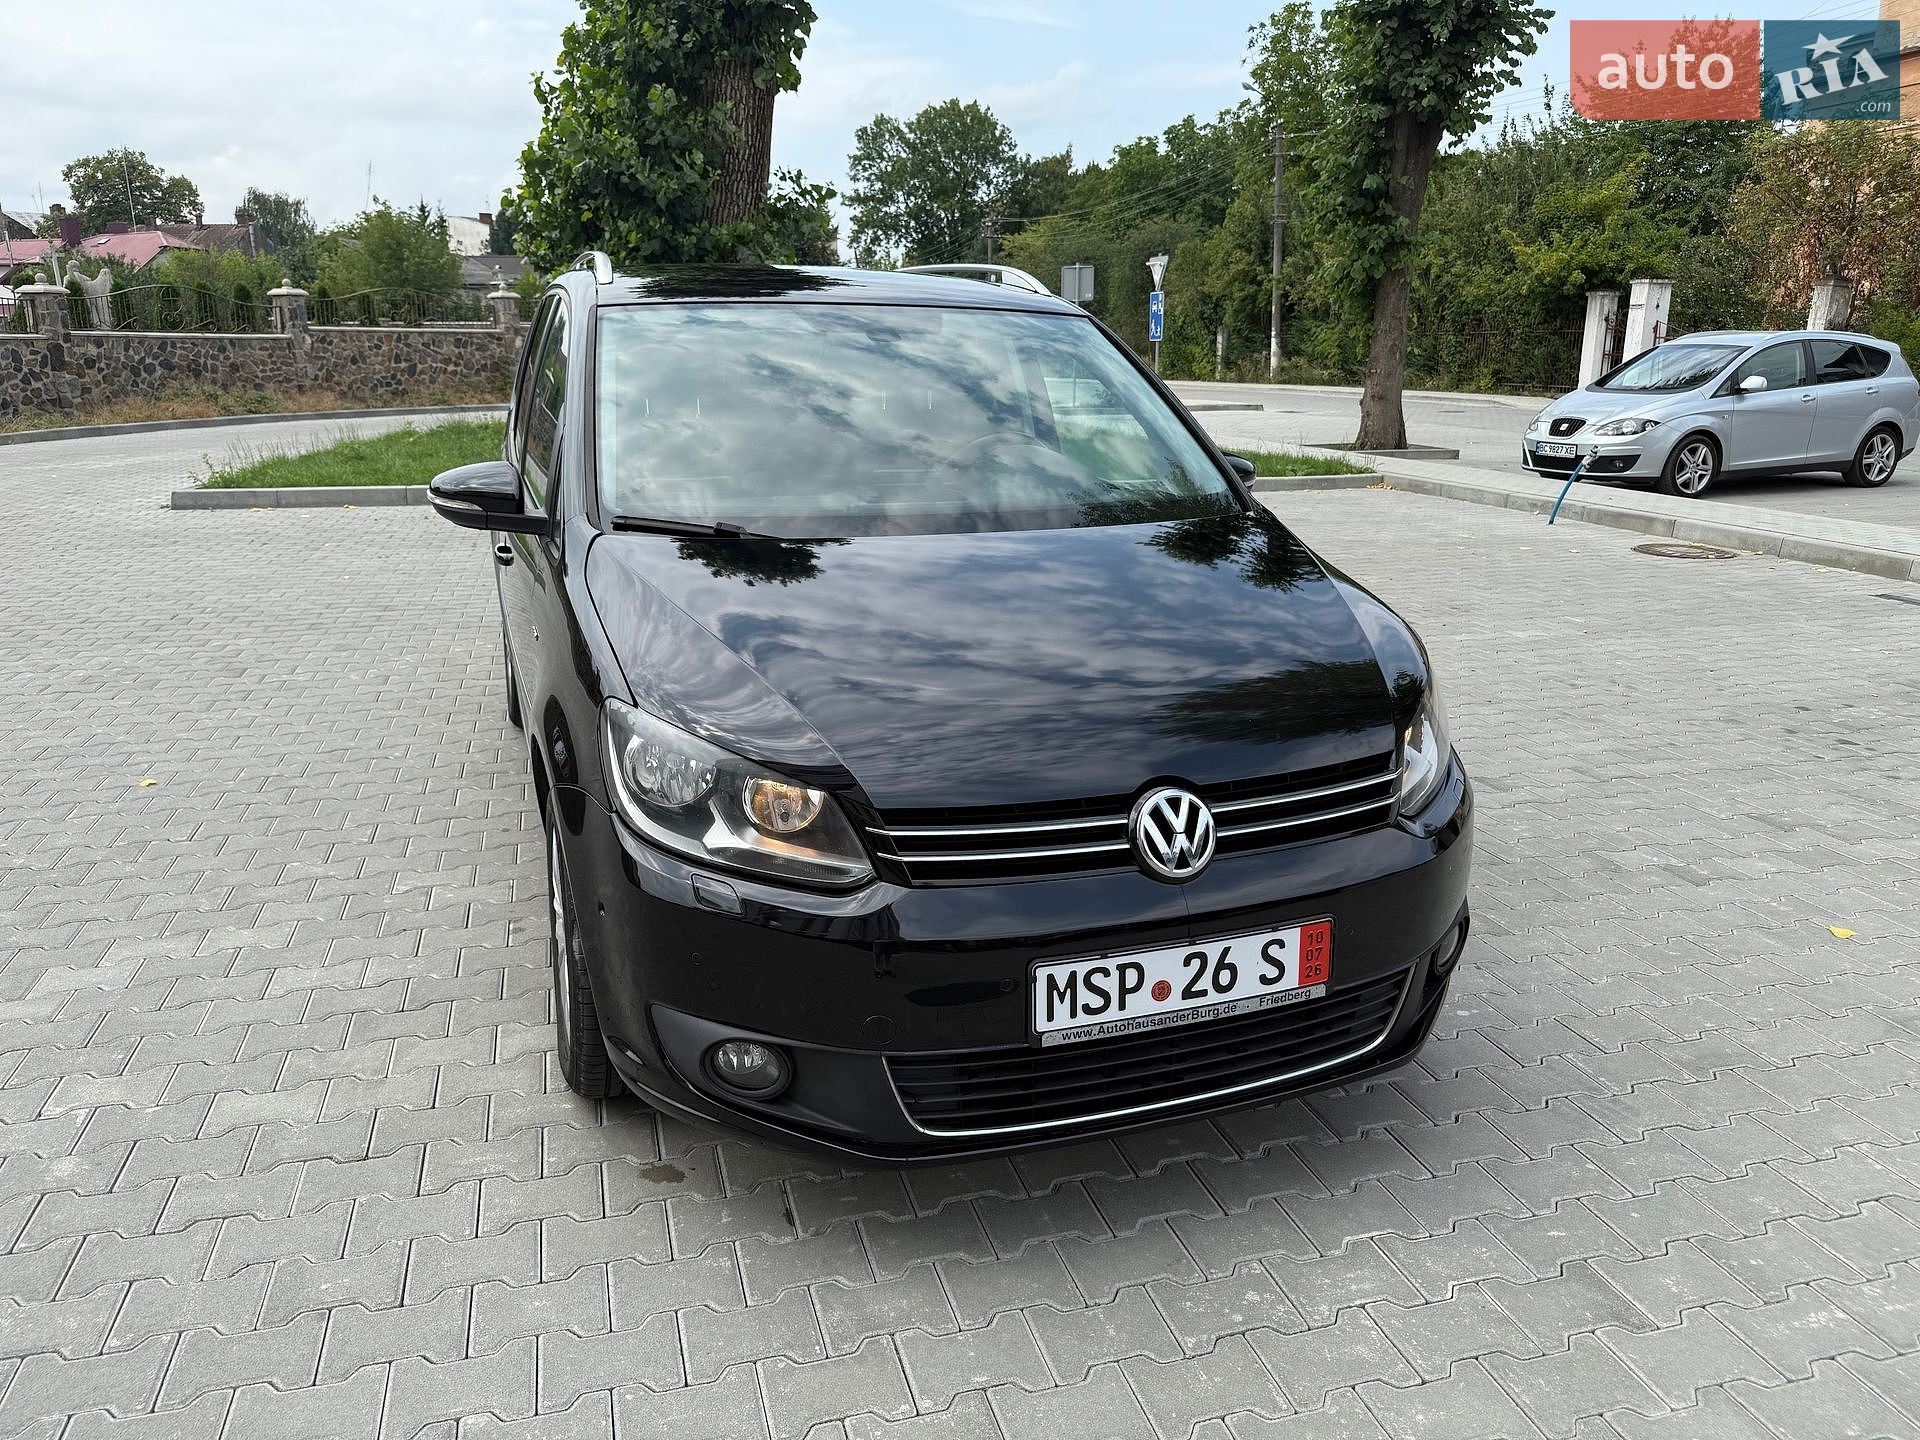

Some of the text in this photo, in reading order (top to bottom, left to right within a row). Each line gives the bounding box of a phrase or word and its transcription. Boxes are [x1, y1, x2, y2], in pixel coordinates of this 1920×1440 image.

[1307, 930, 1324, 945] 10
[1306, 946, 1323, 961] 07
[1305, 963, 1322, 978] 26
[1046, 961, 1145, 1022] MSP
[1181, 946, 1238, 1000] 26
[1258, 938, 1286, 986] S
[1061, 988, 1311, 1041] www.AutohausanderBurg.de Friedberg
